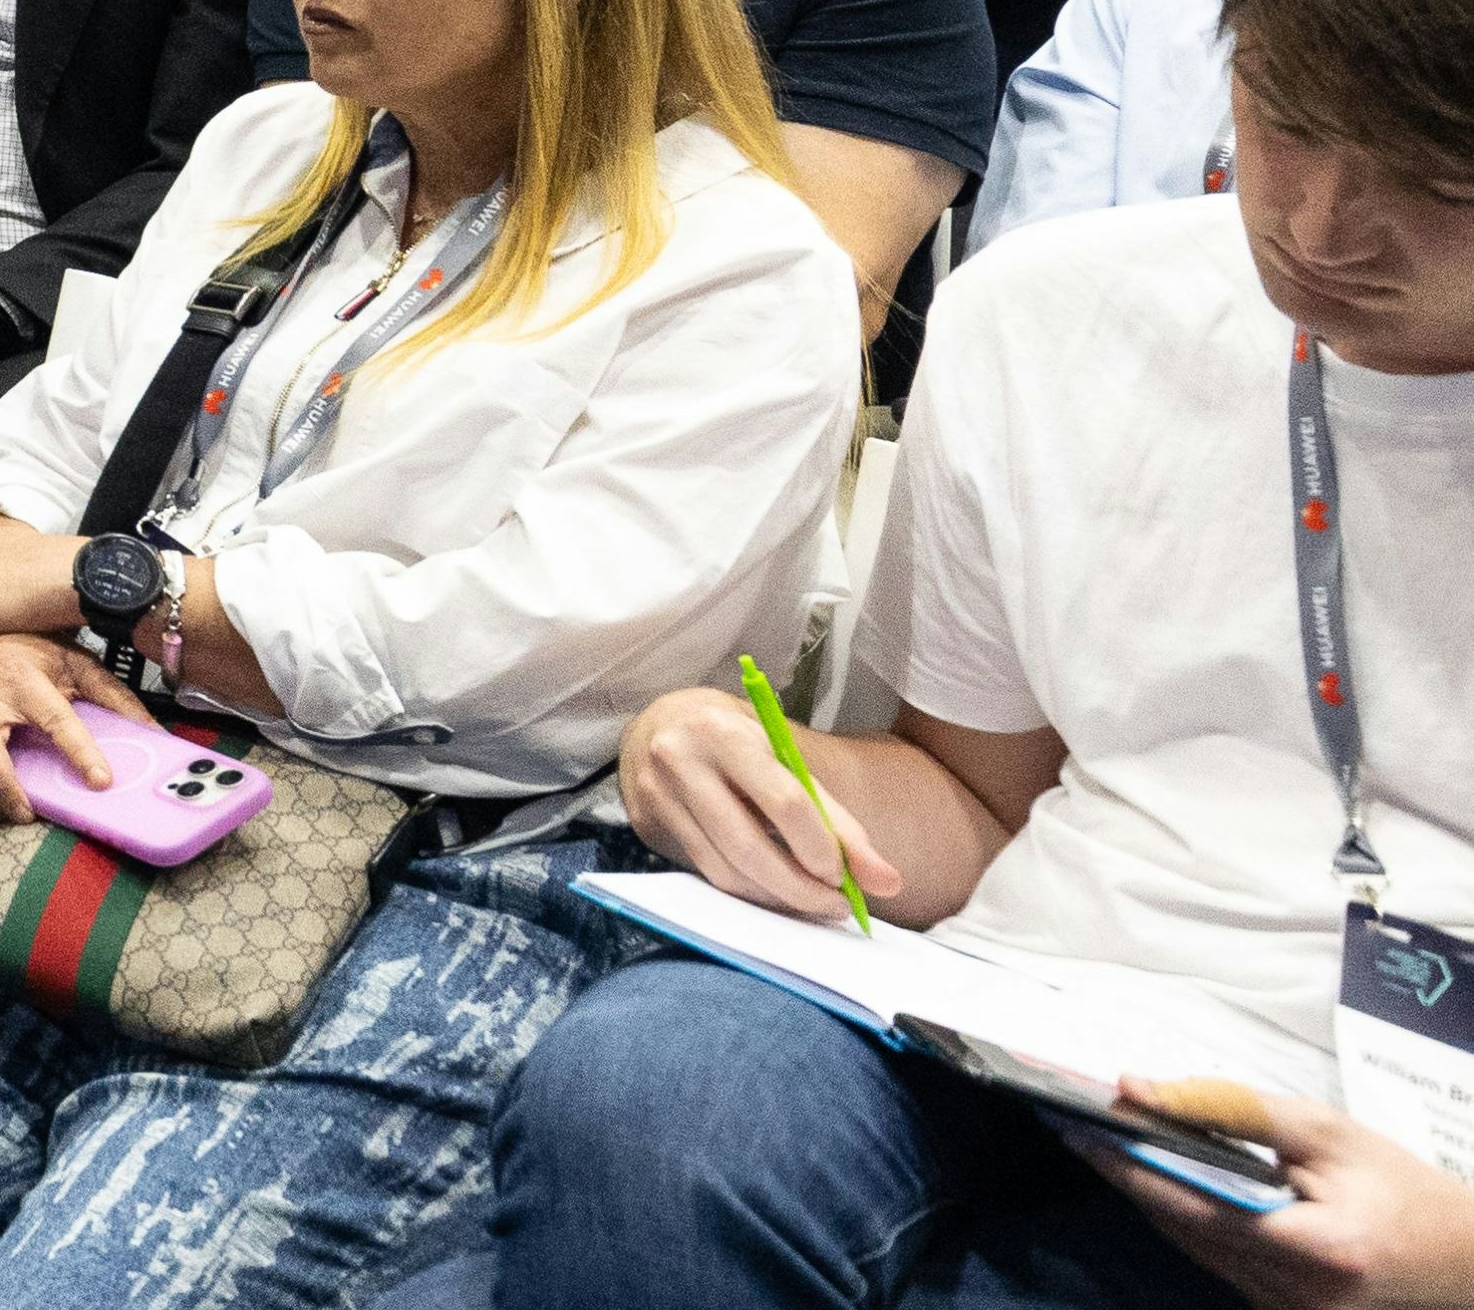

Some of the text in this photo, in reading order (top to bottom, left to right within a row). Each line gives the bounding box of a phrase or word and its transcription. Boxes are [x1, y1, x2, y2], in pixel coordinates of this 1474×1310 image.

[369, 290, 422, 340] HUAWEI
[280, 398, 328, 454] HUAWEI
[1300, 416, 1323, 496] HUAWEI
[1312, 586, 1336, 668] HUAWEI
